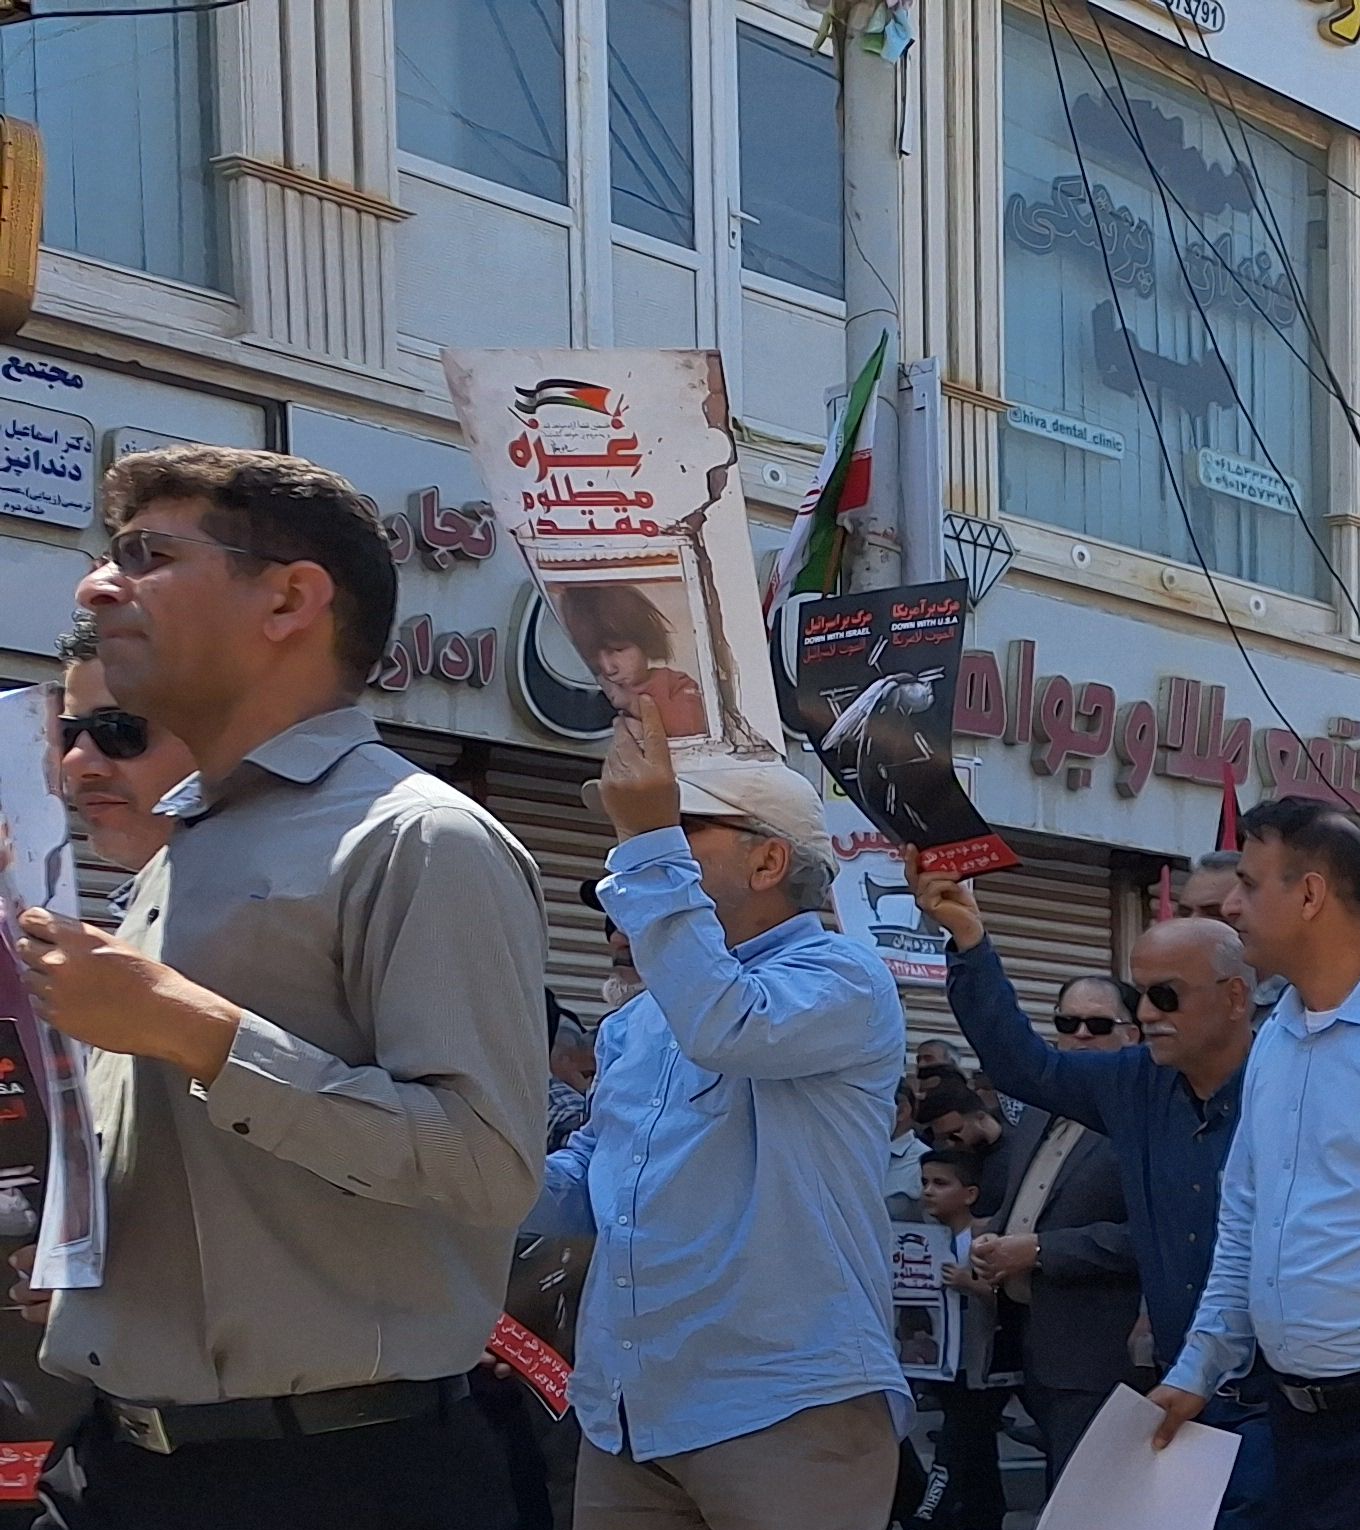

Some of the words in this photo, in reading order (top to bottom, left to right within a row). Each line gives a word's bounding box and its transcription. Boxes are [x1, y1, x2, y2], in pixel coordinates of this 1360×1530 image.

[1, 355, 84, 390] مجتمع
[507, 416, 643, 484] غزه
[1022, 410, 1123, 453] hiva_dental_clinic
[521, 473, 654, 515] مظلوم
[804, 636, 826, 645] DOWN
[826, 632, 845, 641] WITH
[845, 627, 871, 638] ISRAEL
[891, 622, 916, 631] DOWN
[916, 619, 937, 628] WITH
[953, 639, 1118, 792] جواه
